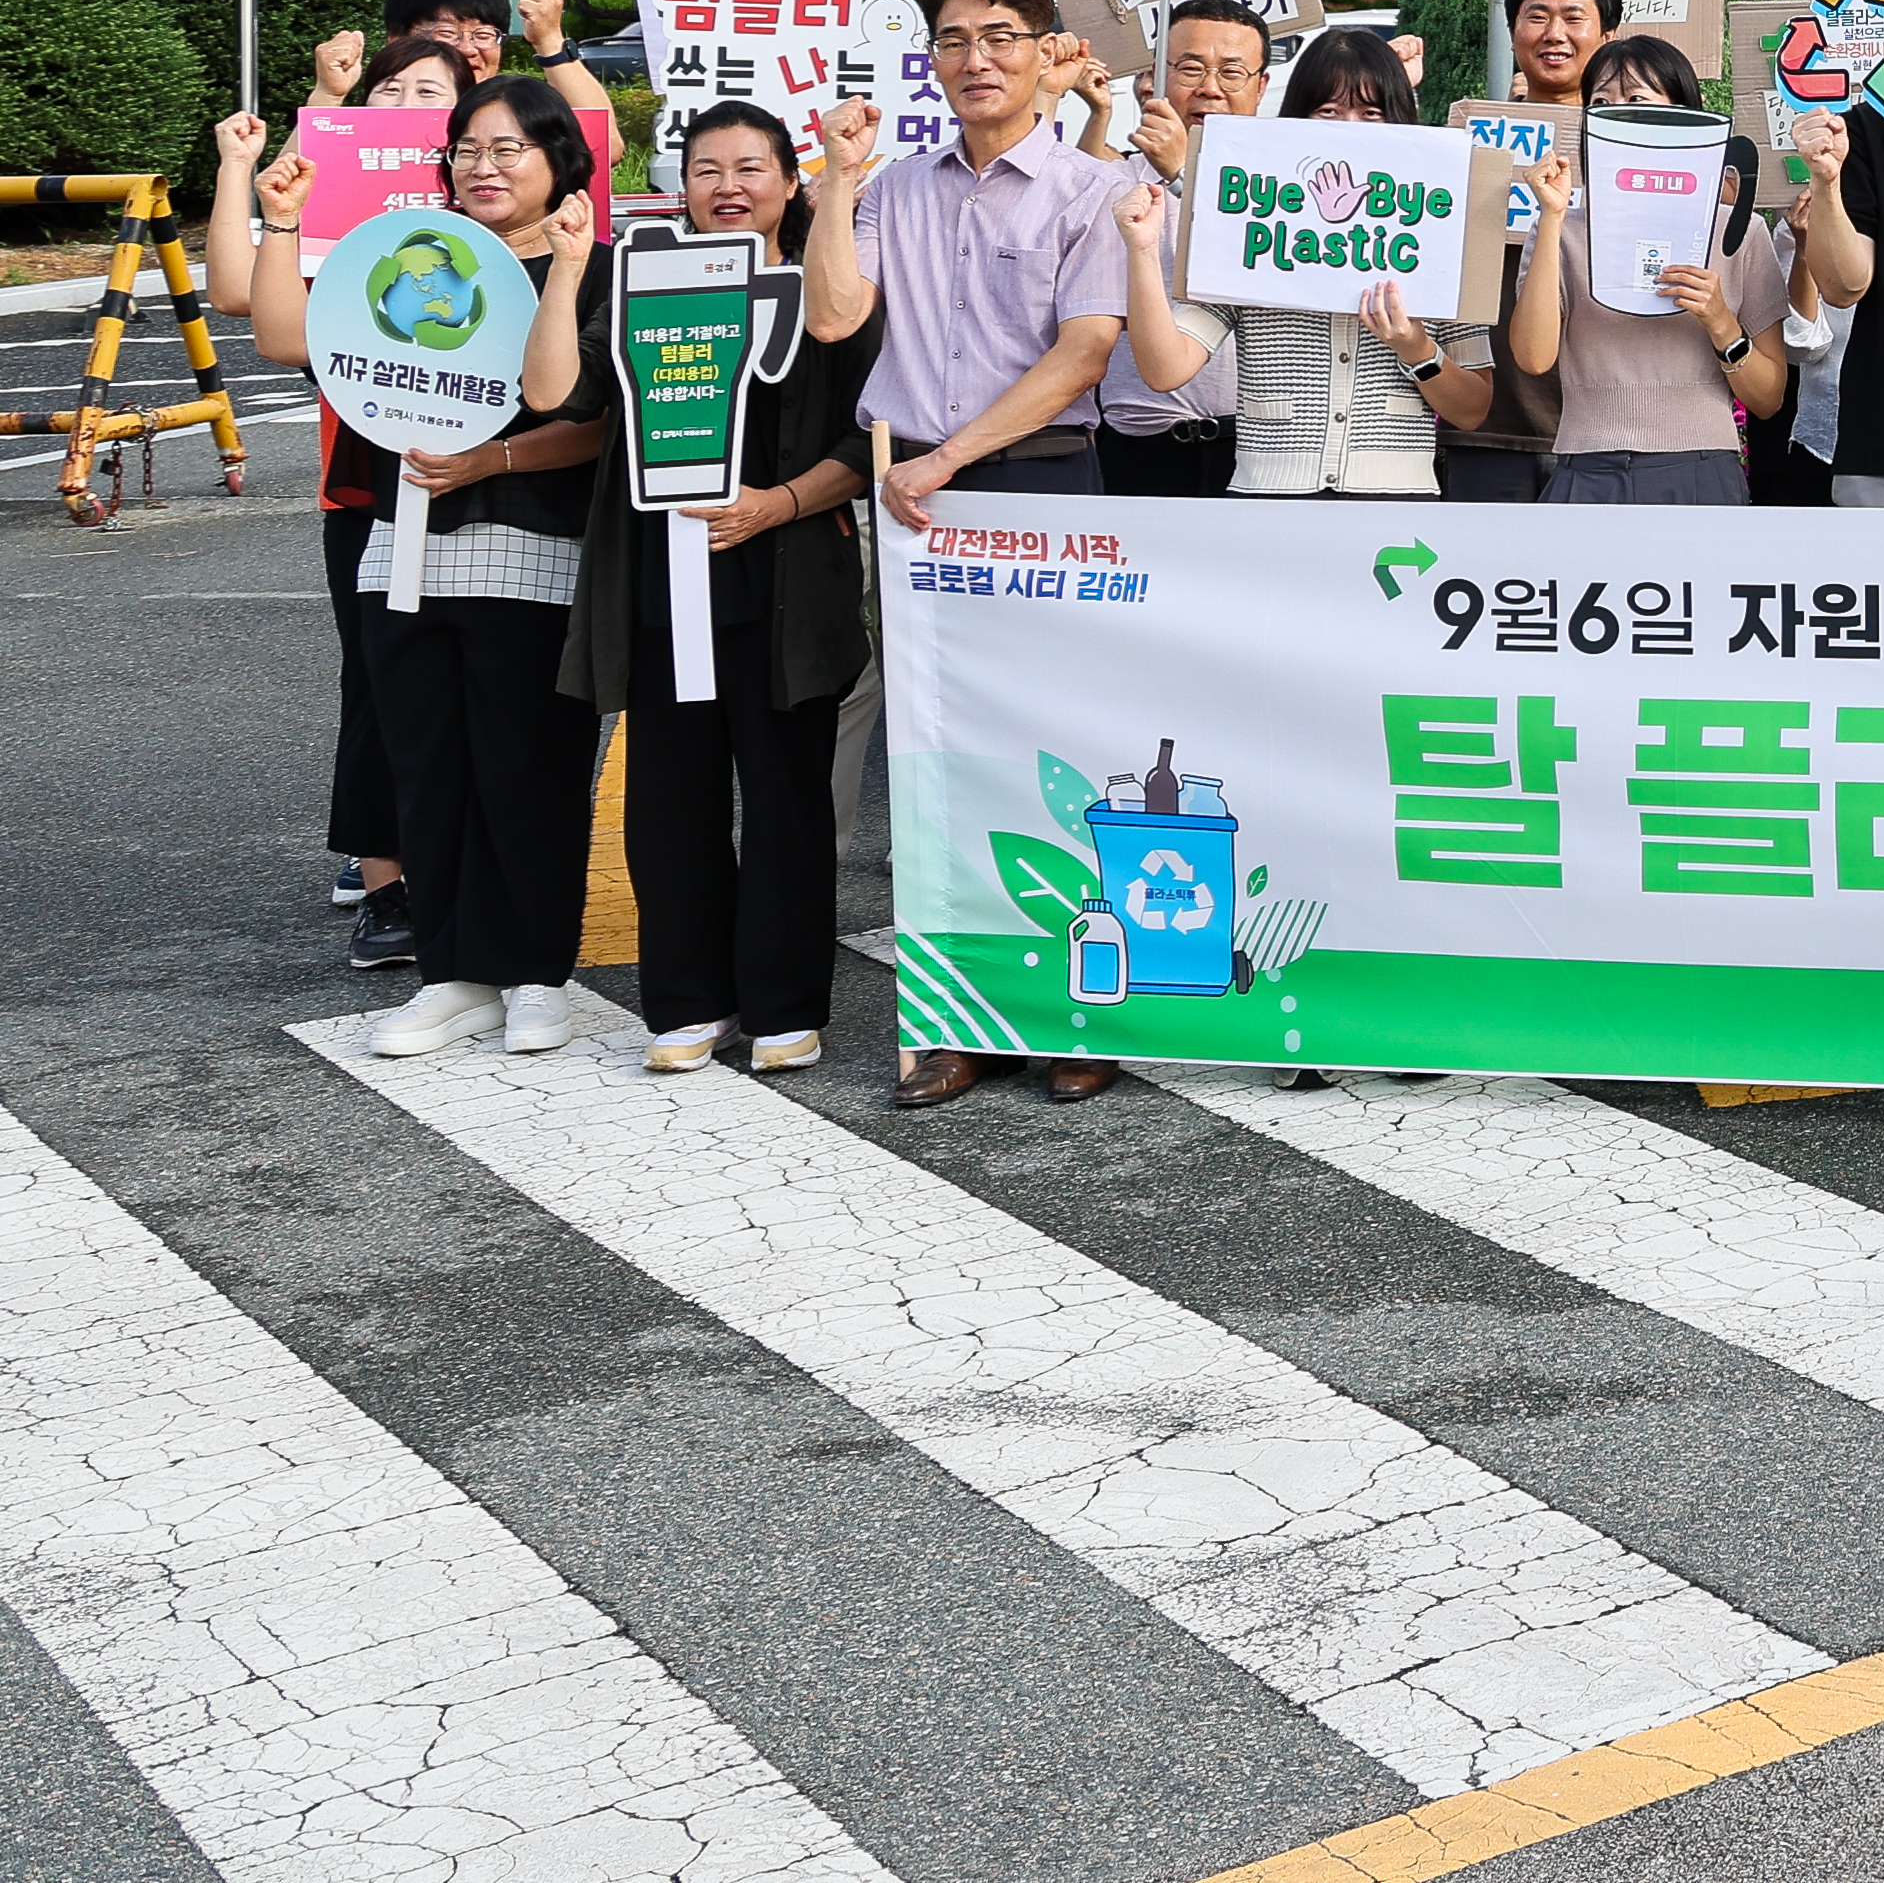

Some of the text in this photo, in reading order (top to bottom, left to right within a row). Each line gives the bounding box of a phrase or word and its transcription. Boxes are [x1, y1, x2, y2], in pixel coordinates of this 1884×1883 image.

[1843, 27, 1884, 40] 실천으로
[667, 45, 755, 97] 쓰는
[778, 47, 875, 101] 나는
[1852, 59, 1872, 71] 실현
[1217, 166, 1304, 217] Bye
[1365, 170, 1454, 225] Bye
[1242, 222, 1420, 274] Plastic
[1687, 230, 1702, 265] bler
[633, 324, 742, 344] 1회용컵 거절하고
[660, 343, 713, 364] 텀블러
[328, 351, 508, 407] 지구 살리는 재활용
[652, 364, 720, 384] (다회용컵)
[646, 384, 725, 403] 사용합시다~
[384, 407, 465, 430] 김해시 자원순환과
[927, 527, 1128, 566] 대전환의 시작,
[909, 561, 1150, 603] 글로컬 시티 김해!
[1433, 577, 1696, 657] 9월6일
[1380, 693, 1578, 890] 탈
